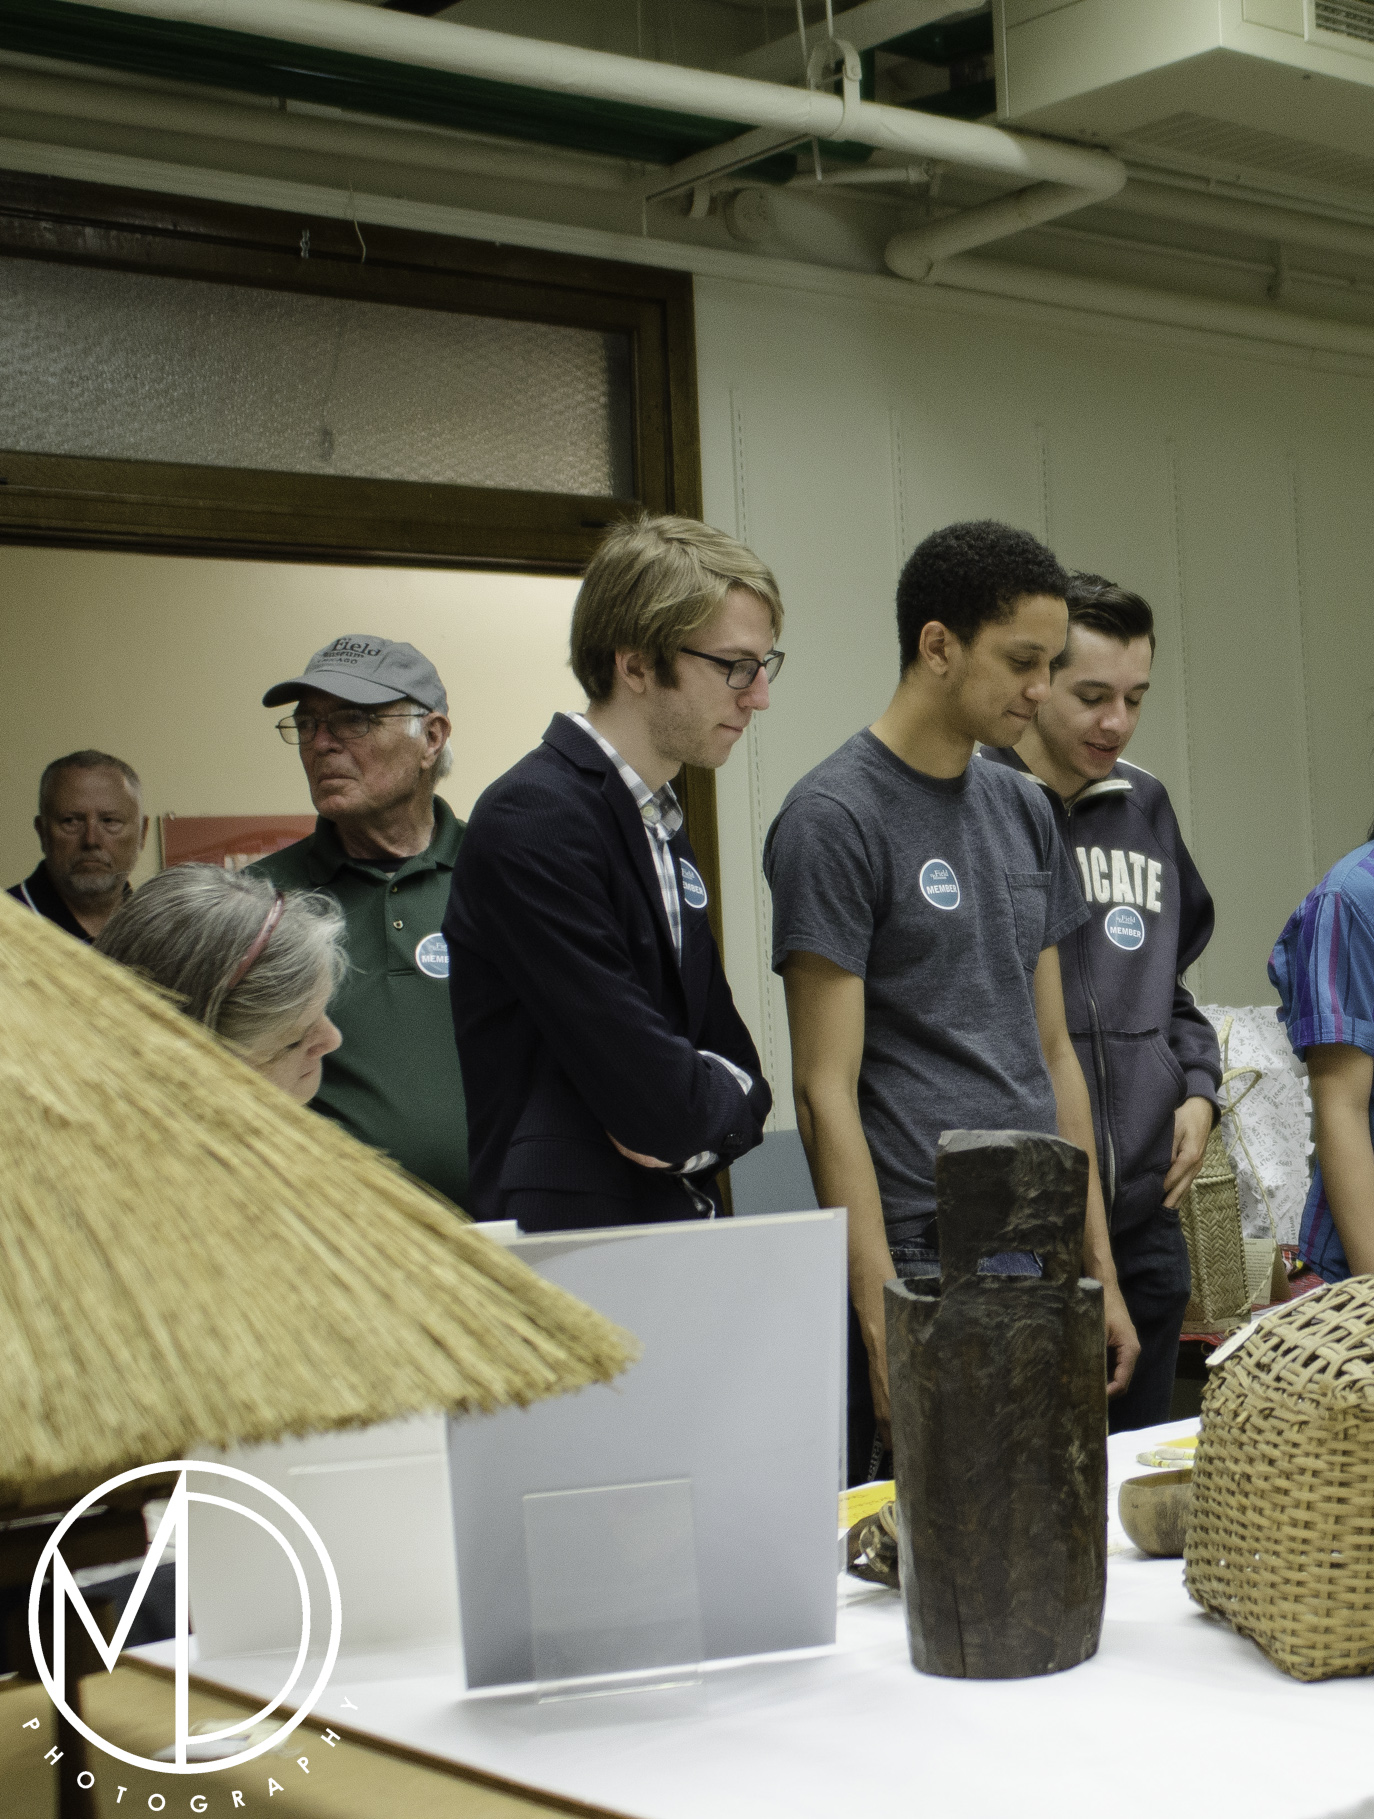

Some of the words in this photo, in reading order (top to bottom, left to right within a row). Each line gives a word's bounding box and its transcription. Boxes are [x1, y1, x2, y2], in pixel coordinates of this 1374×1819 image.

[331, 638, 381, 656] Field
[926, 884, 958, 895] MEMBER
[1110, 926, 1141, 938] MEMBER
